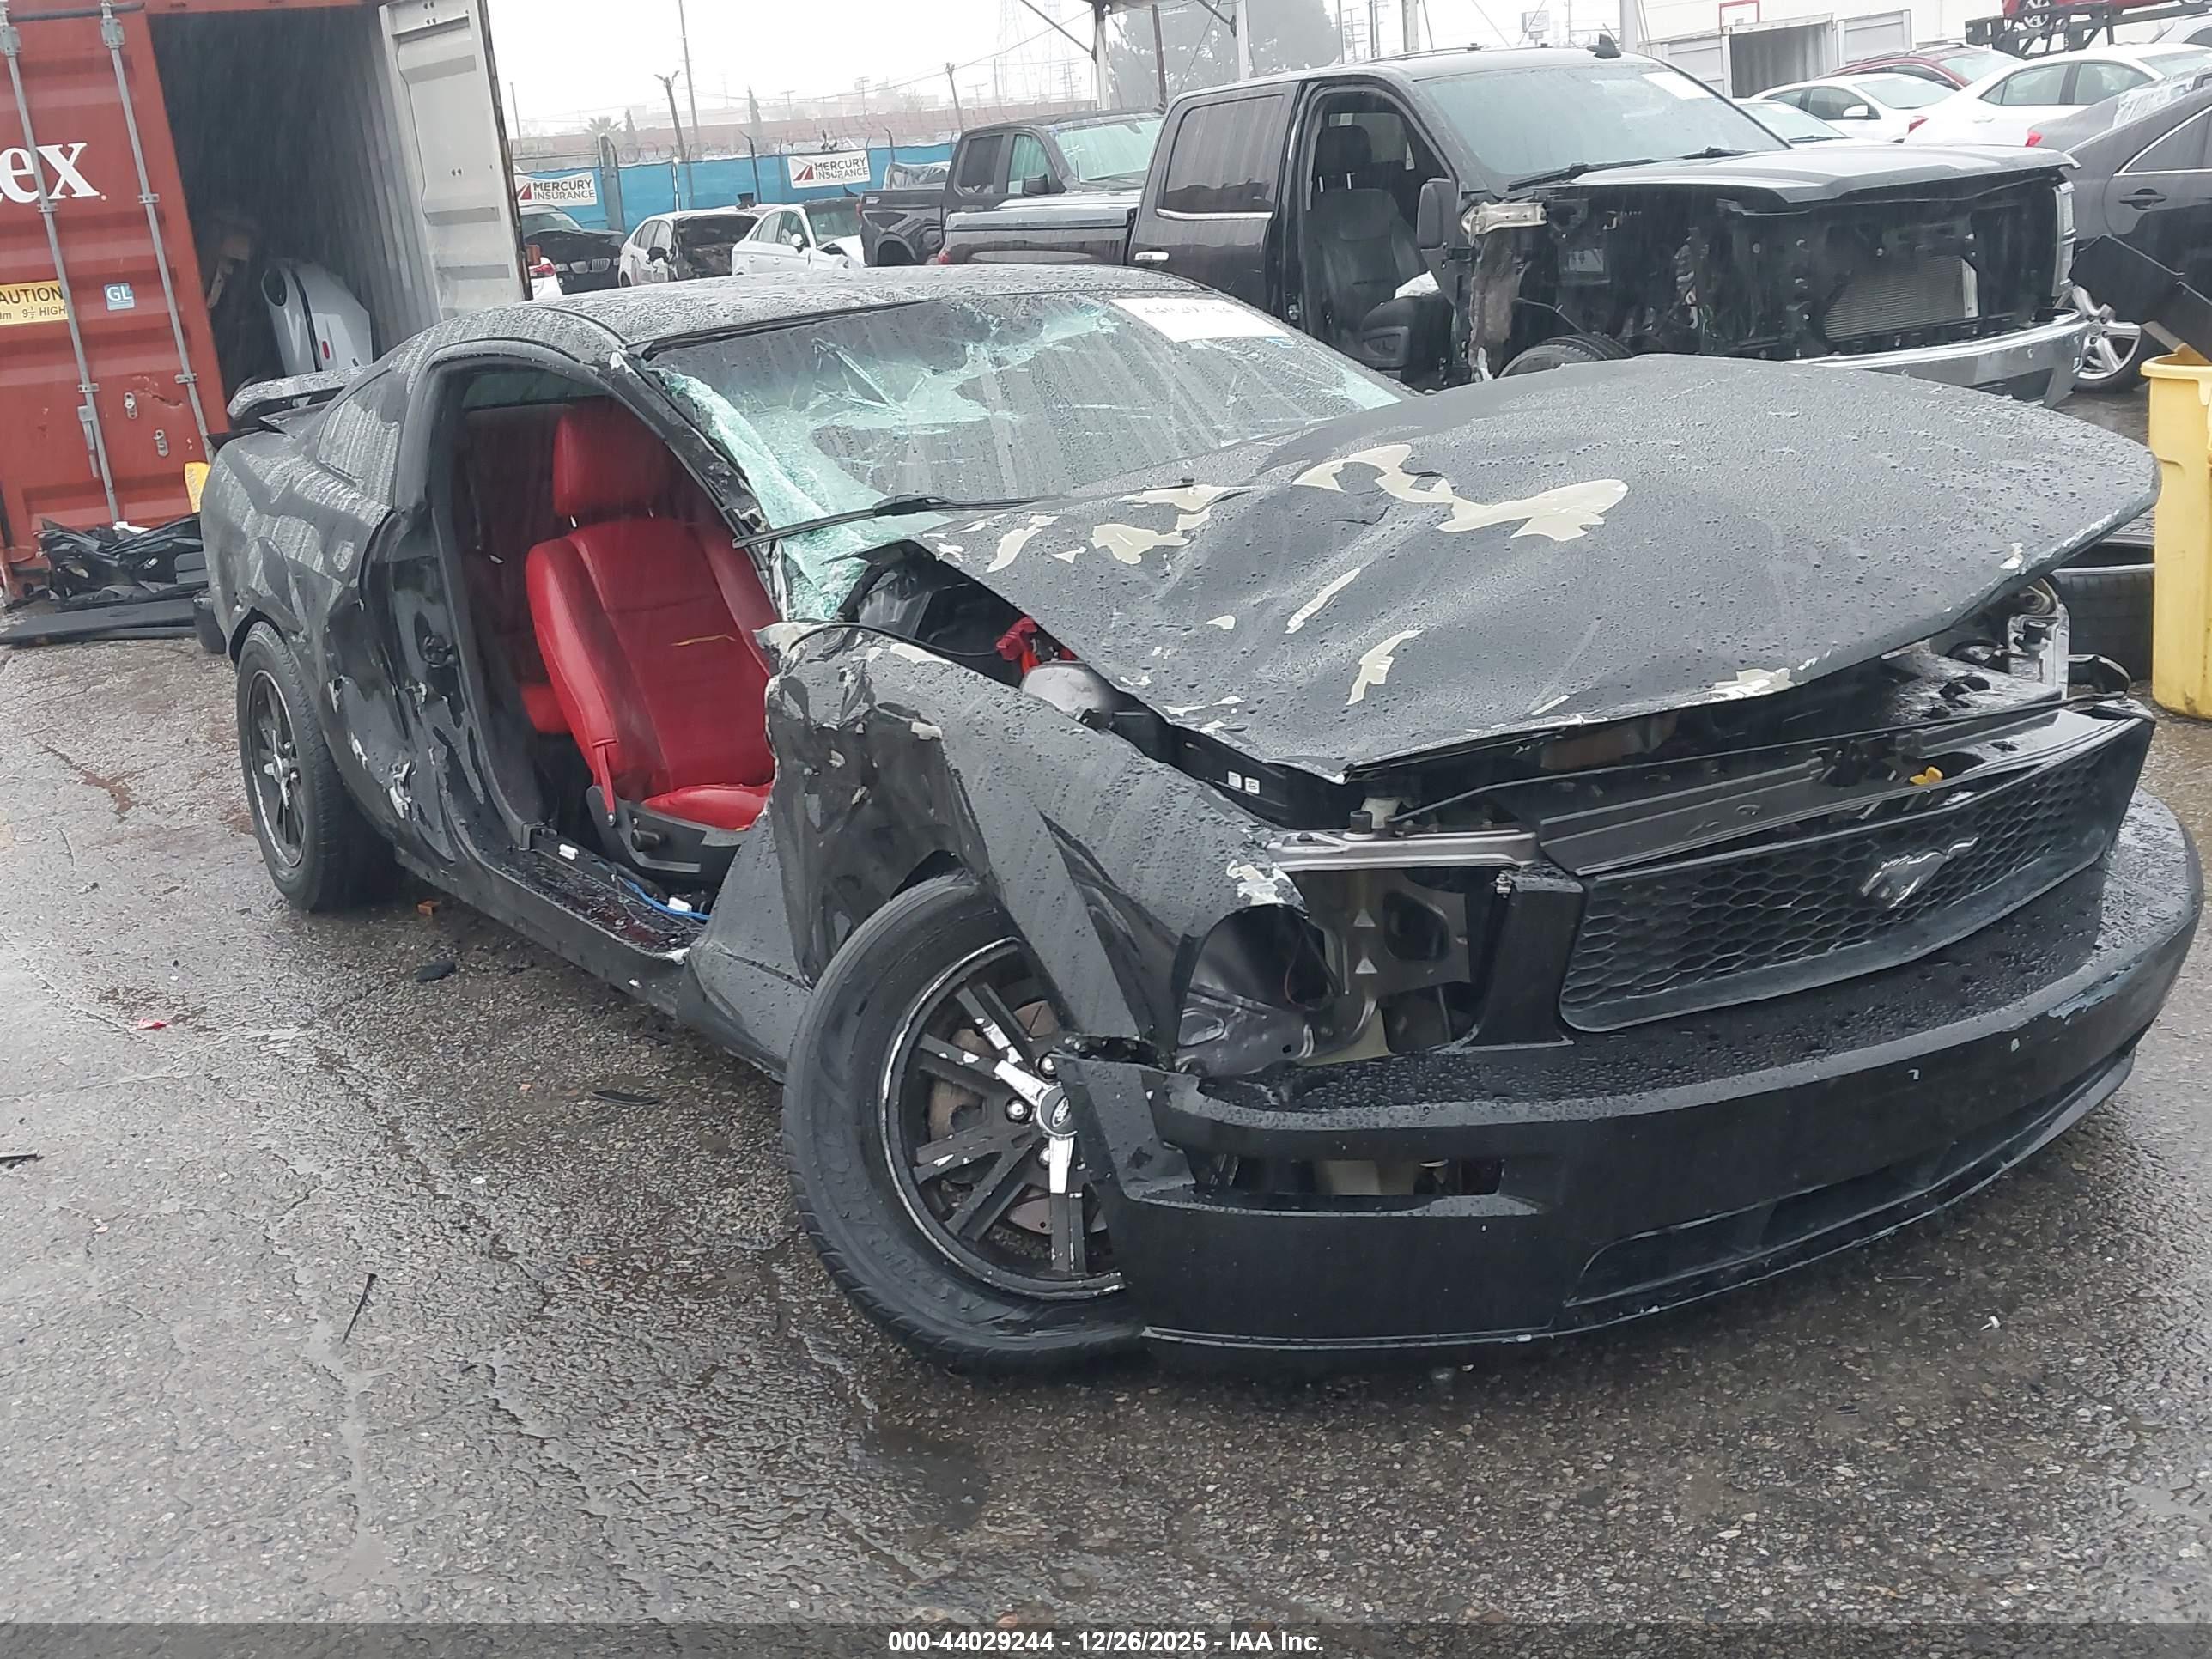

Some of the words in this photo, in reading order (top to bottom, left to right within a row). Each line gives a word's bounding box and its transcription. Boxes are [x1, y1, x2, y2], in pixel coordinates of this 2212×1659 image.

[814, 157, 866, 171] MERCURY
[816, 167, 869, 179] INSURANCE
[533, 179, 592, 191] MERCURY
[534, 191, 595, 200] INSURANCE
[40, 305, 66, 316] HIGH
